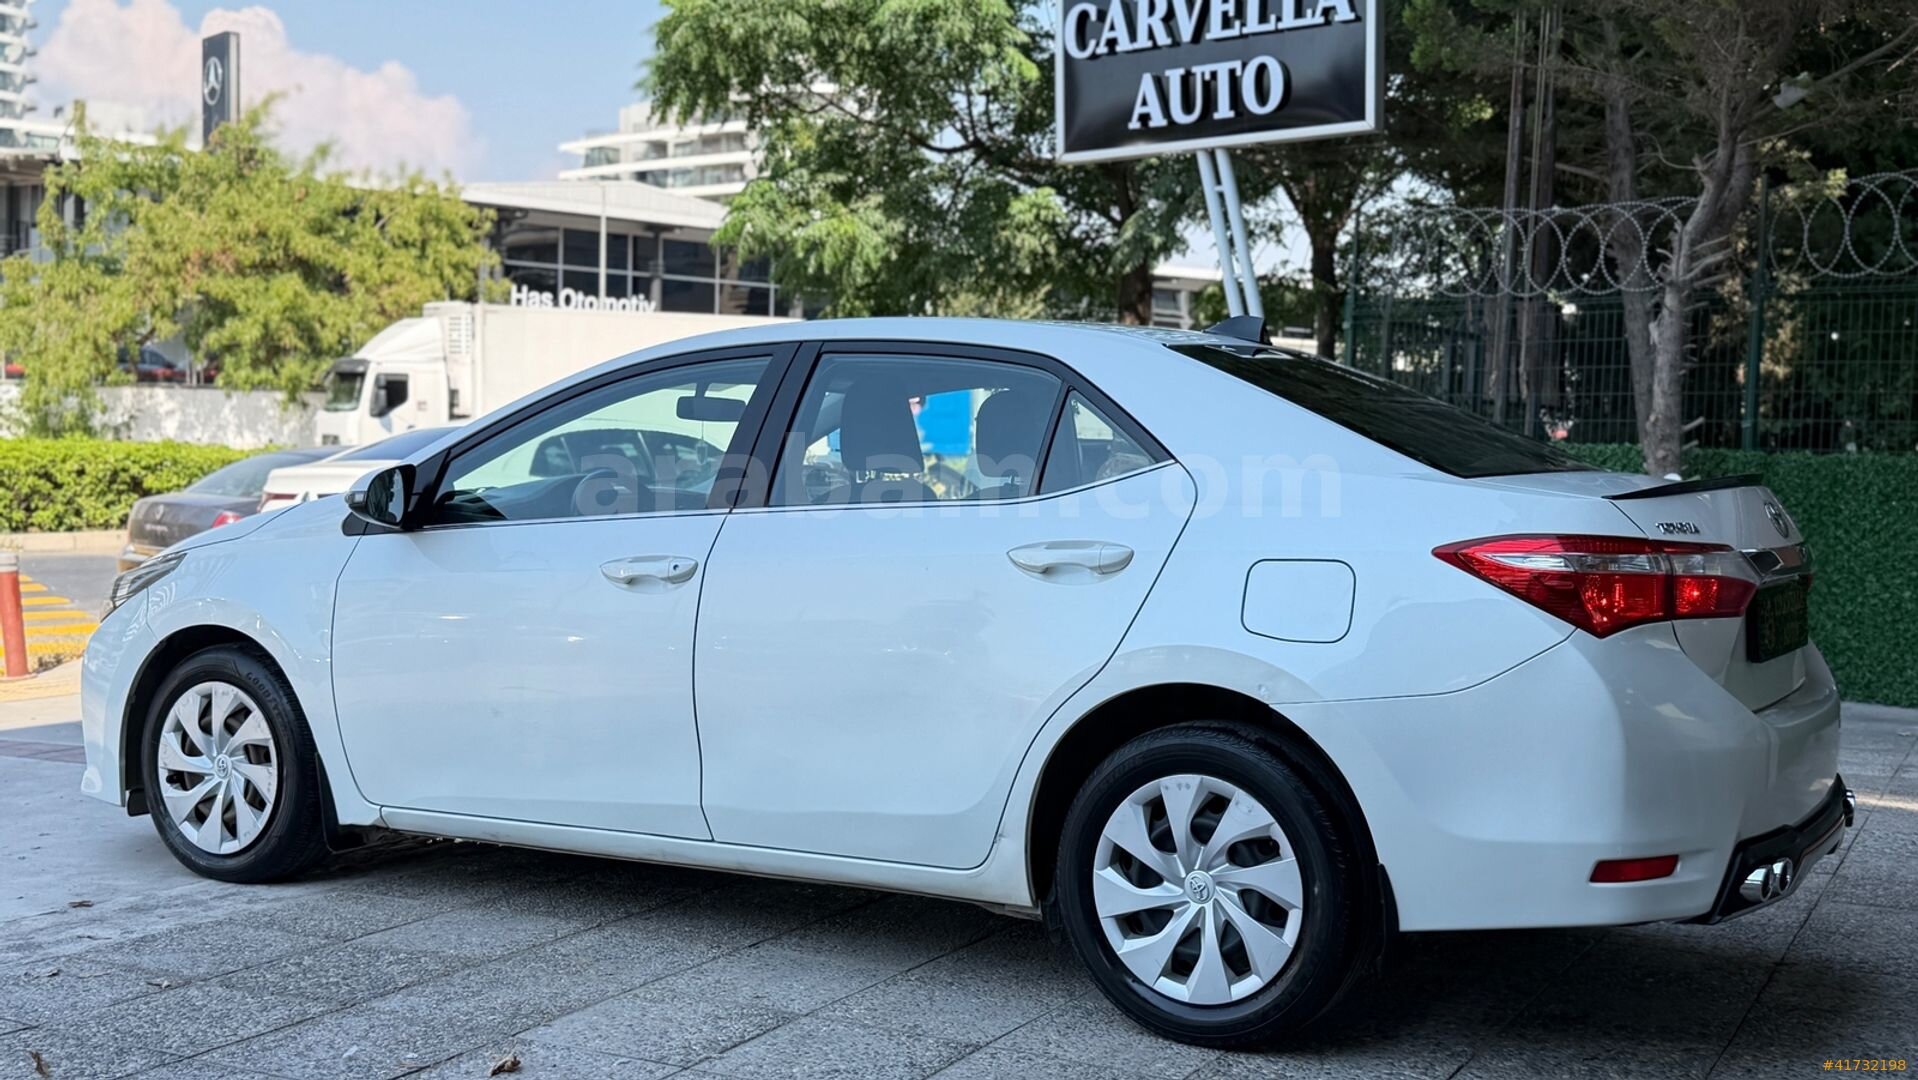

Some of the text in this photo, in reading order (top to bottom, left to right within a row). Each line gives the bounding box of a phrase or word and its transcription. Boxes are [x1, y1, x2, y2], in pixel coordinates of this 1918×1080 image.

[1128, 55, 1284, 130] AUTO
[510, 284, 657, 312] Has Otomotiv
